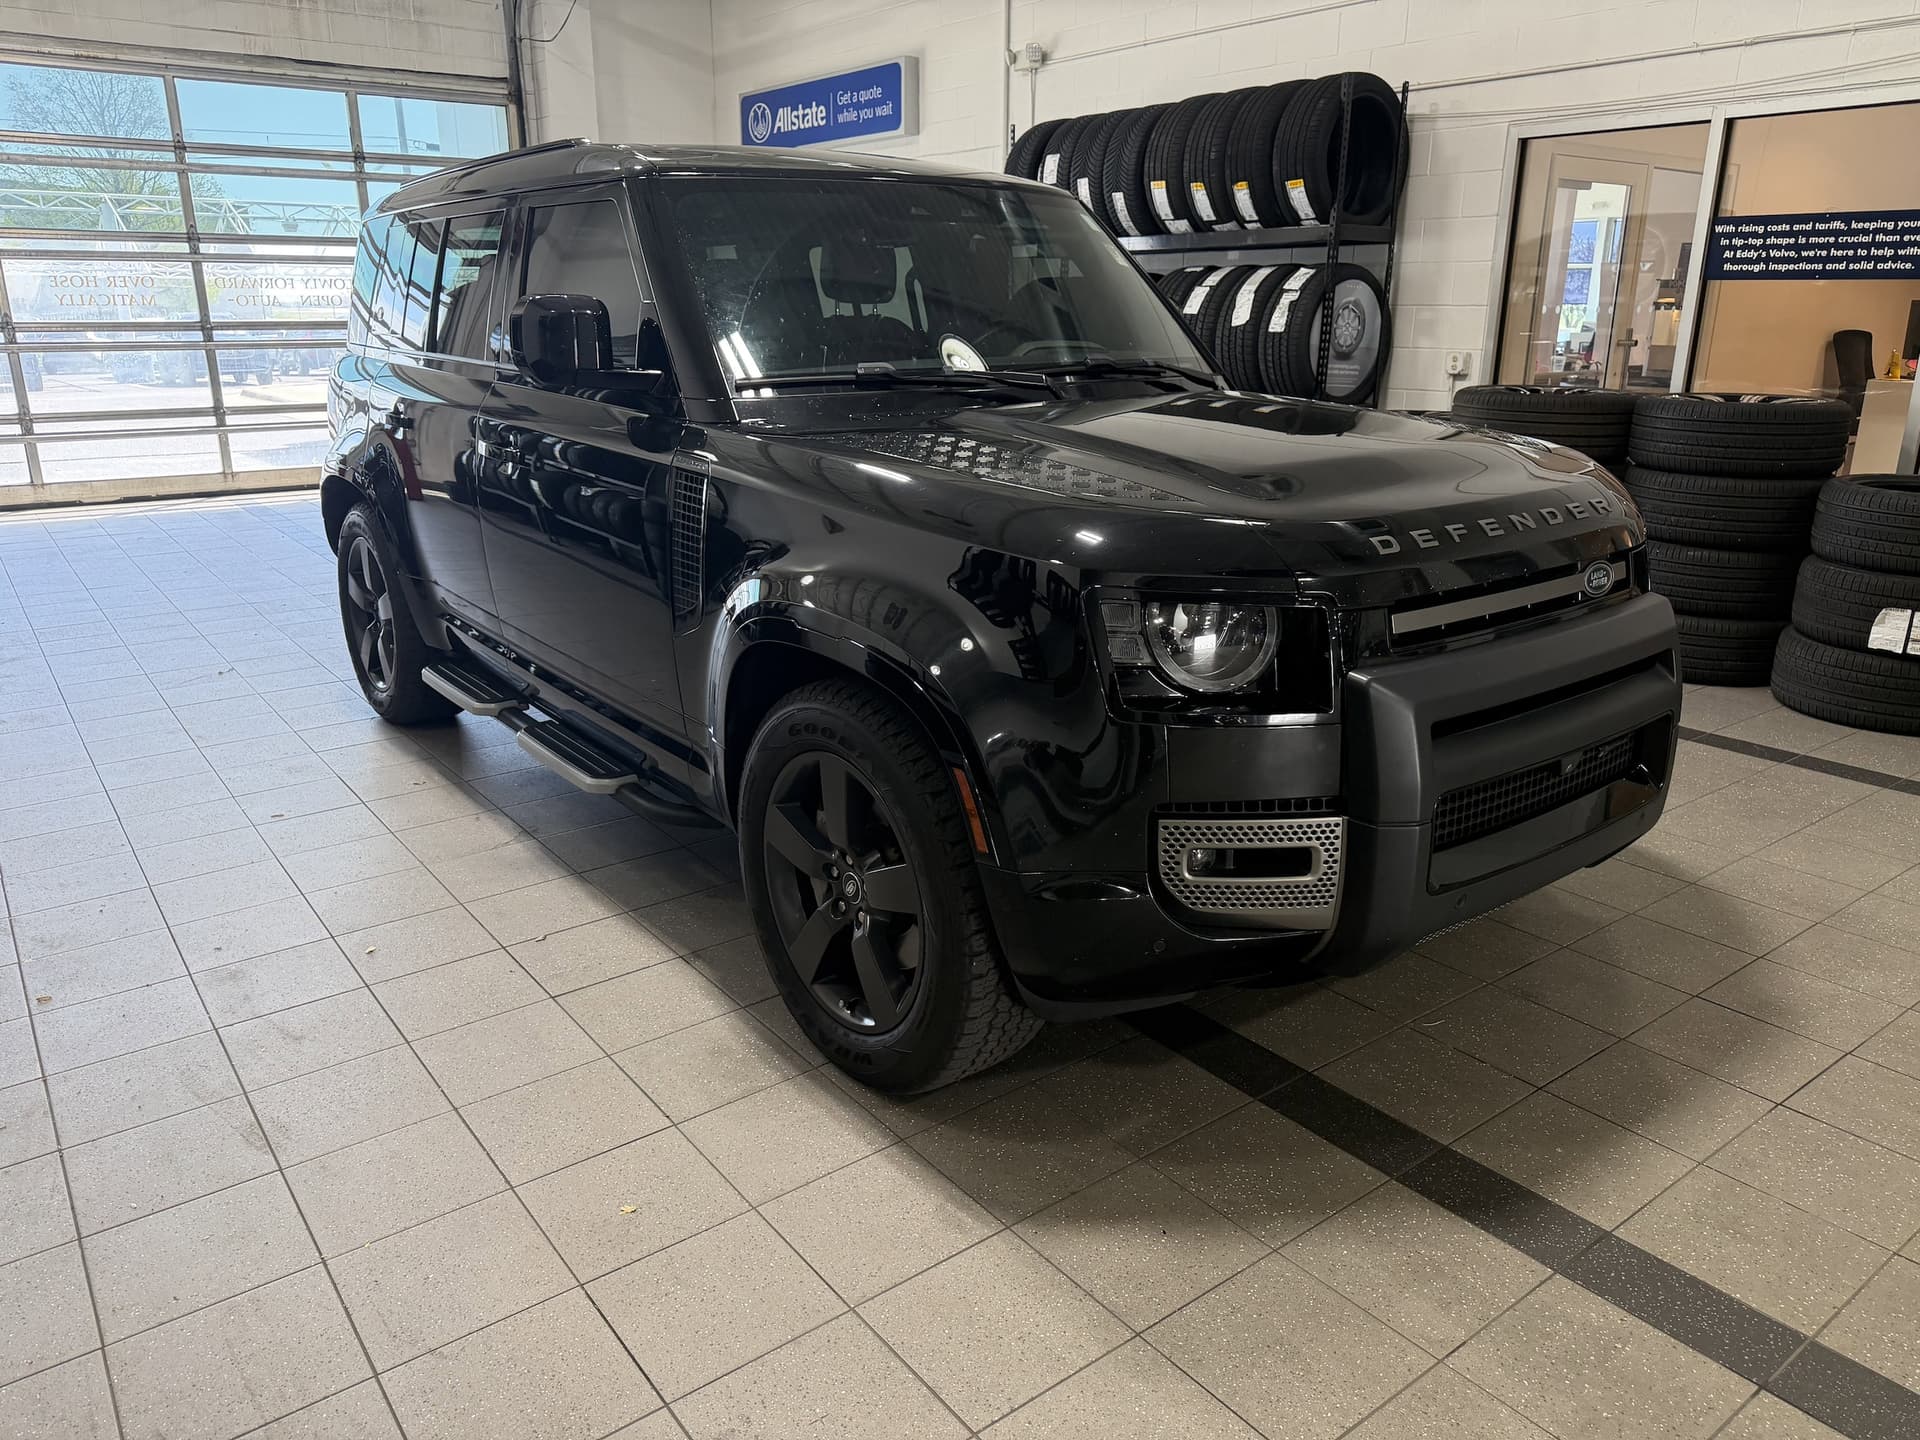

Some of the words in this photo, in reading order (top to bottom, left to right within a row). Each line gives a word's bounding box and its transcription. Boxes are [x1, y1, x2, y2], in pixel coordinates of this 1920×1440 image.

[837, 90, 851, 106] Get
[852, 92, 858, 103] a
[858, 85, 882, 103] quote
[773, 101, 826, 134] Allstate
[837, 108, 857, 124] while
[858, 108, 874, 123] you
[875, 101, 893, 117] wait
[1714, 224, 1736, 233] With
[1738, 223, 1765, 234] rising
[1767, 223, 1790, 232] costs
[1793, 221, 1813, 231] and
[1815, 220, 1848, 231] tariffs,
[1851, 219, 1895, 231] keeping
[1720, 237, 1730, 246] in
[1732, 236, 1764, 247] tip-top
[1765, 236, 1796, 246] shape
[1798, 235, 1806, 244] is
[1809, 235, 1835, 244] more
[1838, 233, 1873, 243] crucial
[1875, 233, 1901, 242] than
[1723, 249, 1734, 259] At
[1736, 249, 1767, 260] Eddy's
[1769, 248, 1799, 259] Volvo,
[1801, 249, 1828, 258] we're
[1830, 247, 1854, 257] here
[1857, 248, 1868, 256] to
[1870, 246, 1895, 258] help
[1897, 246, 1920, 256] with
[1723, 261, 1766, 273] thorough
[1768, 261, 1823, 273] inspections
[1826, 260, 1846, 270] and
[1848, 260, 1875, 270] solid
[1876, 260, 1915, 270] advice.
[1369, 498, 1613, 555] DEFENDER
